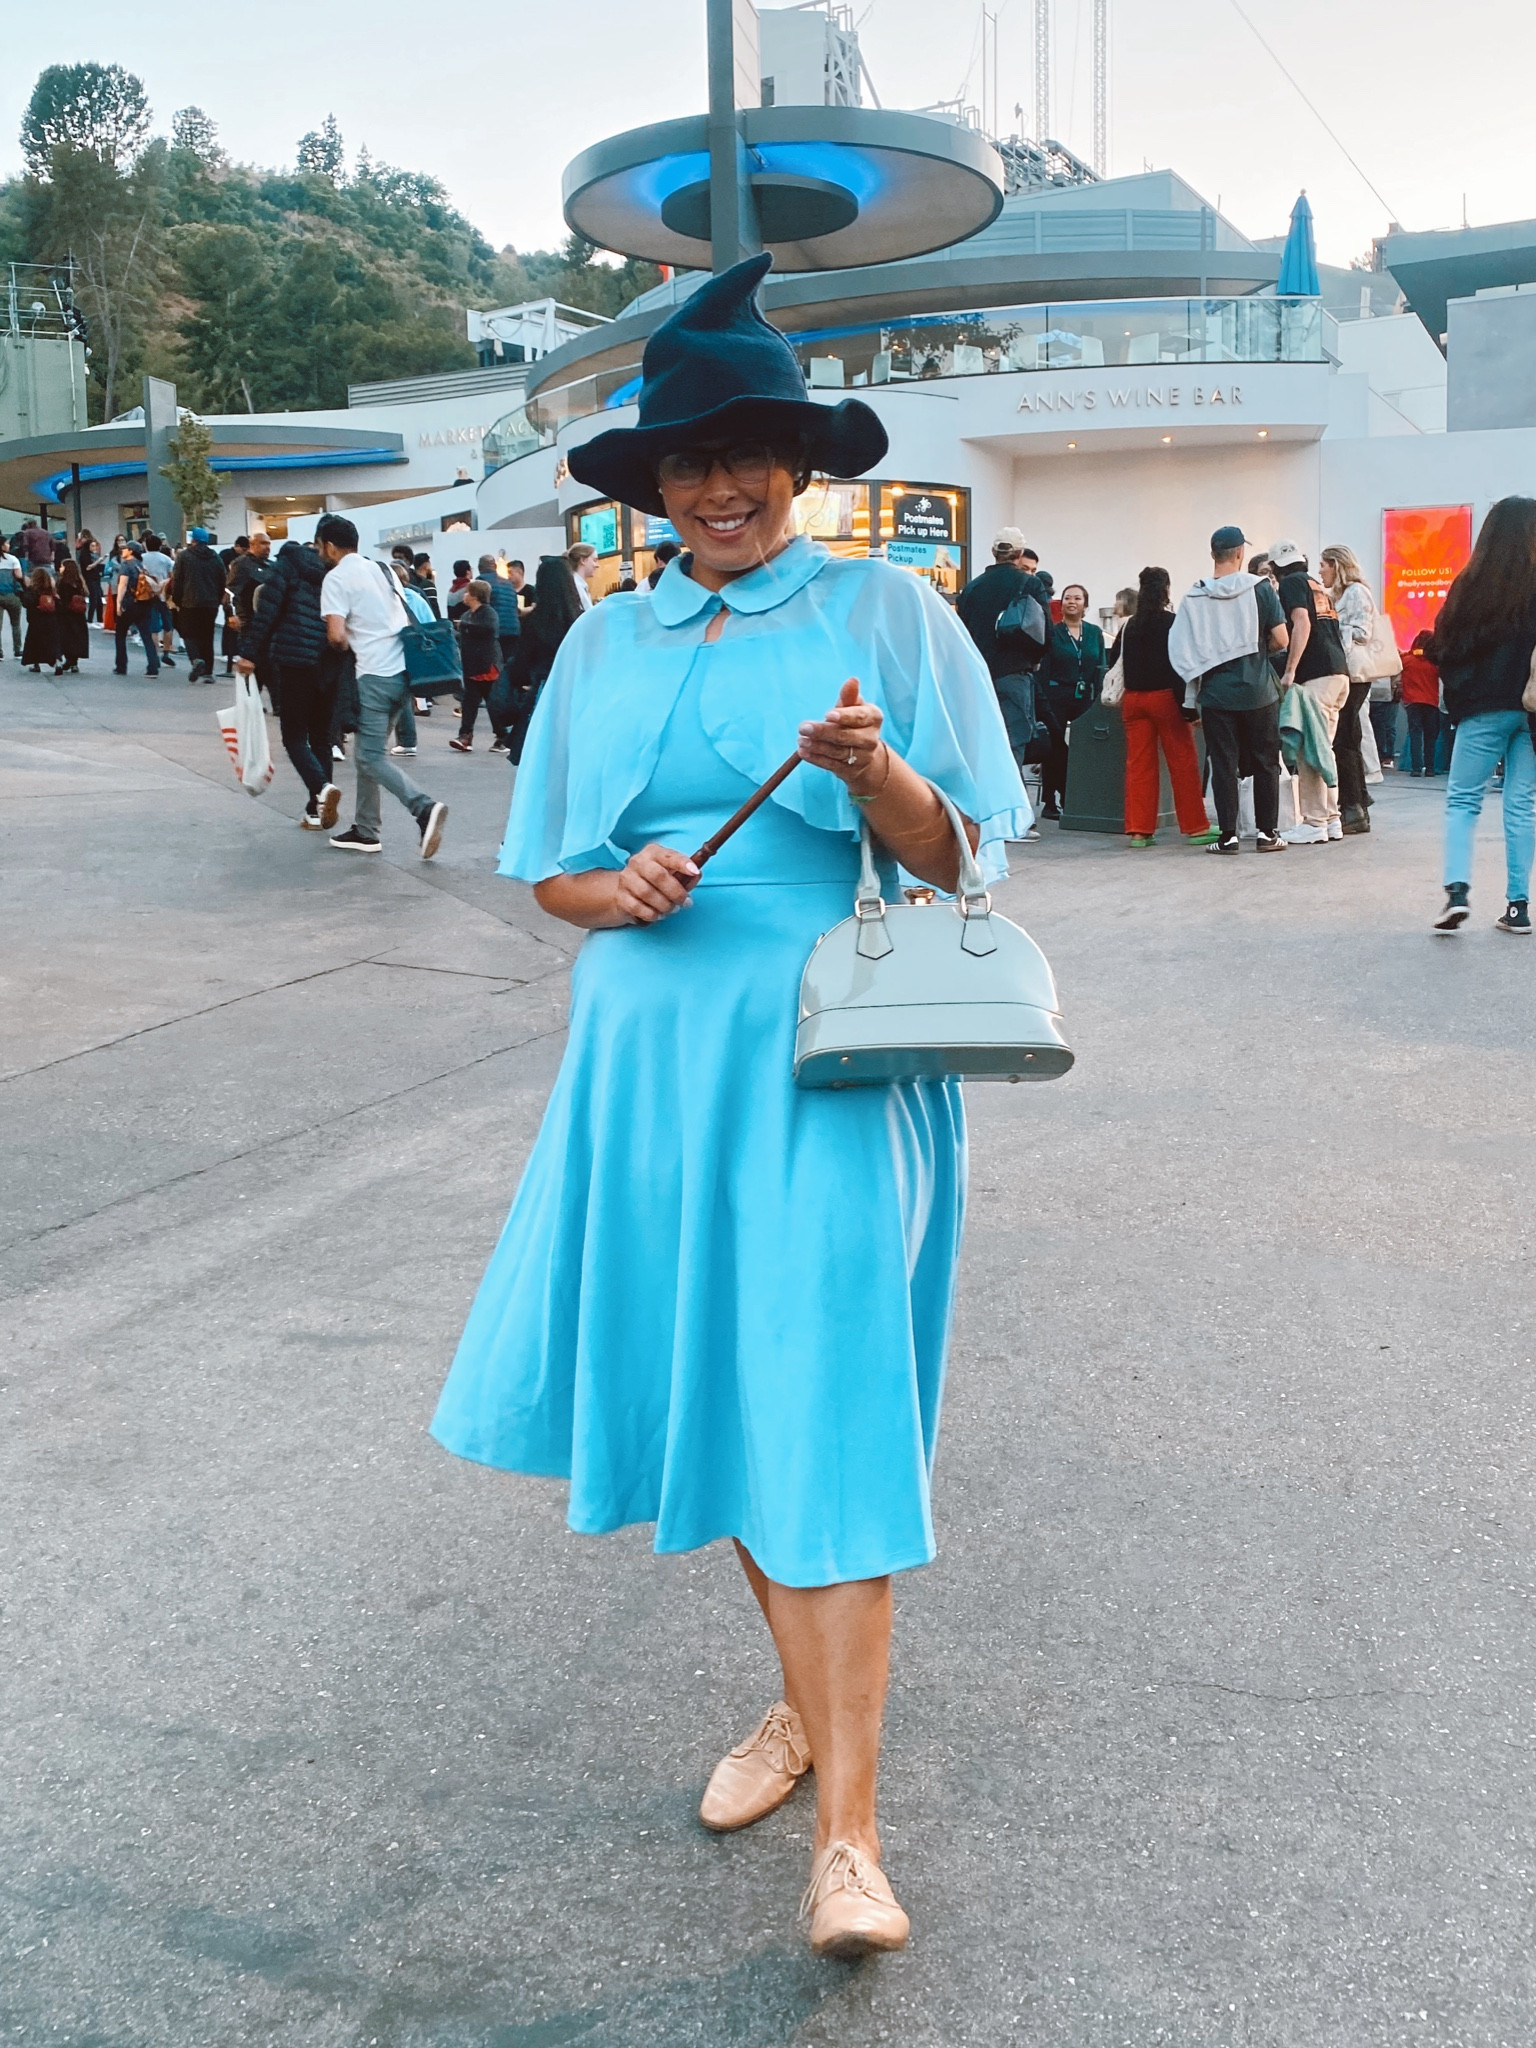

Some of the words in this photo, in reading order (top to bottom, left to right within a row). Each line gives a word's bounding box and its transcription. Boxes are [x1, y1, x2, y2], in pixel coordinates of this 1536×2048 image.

[1017, 388, 1096, 413] ANN'S
[1107, 386, 1180, 408] WINE
[1194, 385, 1243, 406] BAR
[419, 420, 538, 446] MARKETAC
[904, 512, 944, 525] Postmates
[898, 525, 916, 536] Pick
[918, 527, 928, 537] up
[929, 527, 949, 538] Here
[887, 543, 927, 554] Postmates
[887, 554, 913, 564] Pickup
[1401, 568, 1436, 576] FOLLOW
[1397, 579, 1451, 588] @hollywoodbo
